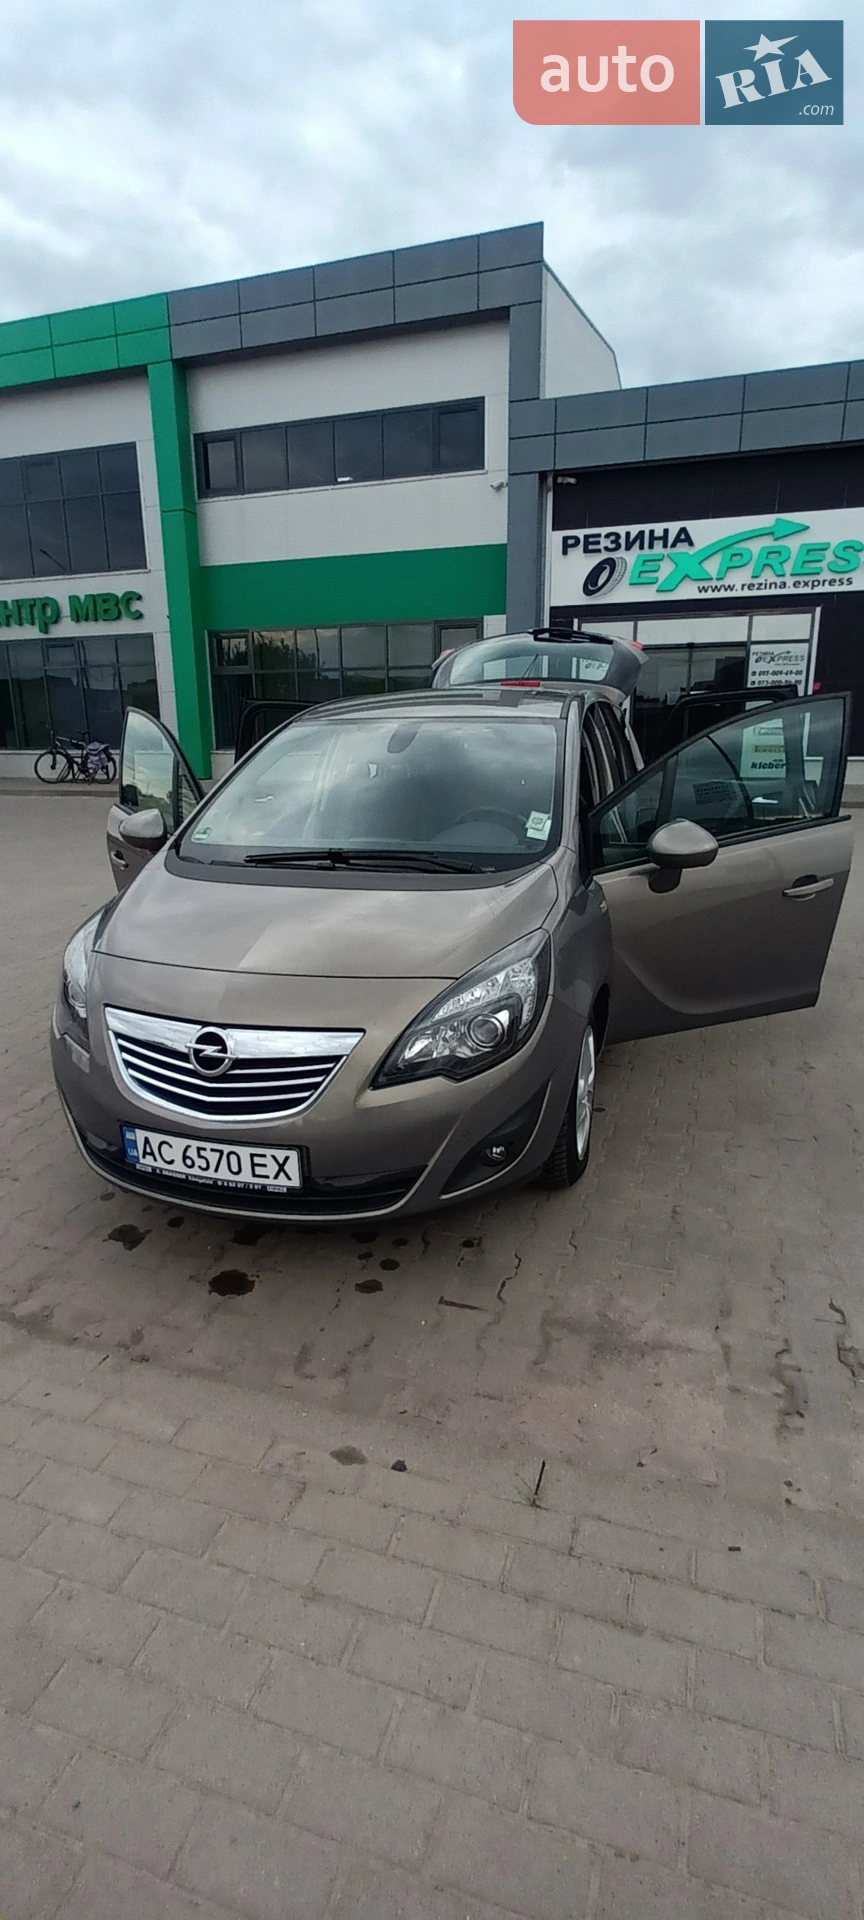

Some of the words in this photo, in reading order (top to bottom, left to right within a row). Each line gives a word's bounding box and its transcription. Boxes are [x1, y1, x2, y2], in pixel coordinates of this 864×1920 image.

[561, 526, 694, 556] РЕЗИНА
[628, 539, 864, 593] EXPRES
[697, 576, 854, 594] www.rezina.express
[0, 596, 61, 634] нтр
[68, 590, 144, 623] МВС
[127, 1147, 139, 1158] UA
[141, 1136, 175, 1165] AC
[181, 1144, 242, 1176] 6570
[249, 1152, 292, 1181] EX
